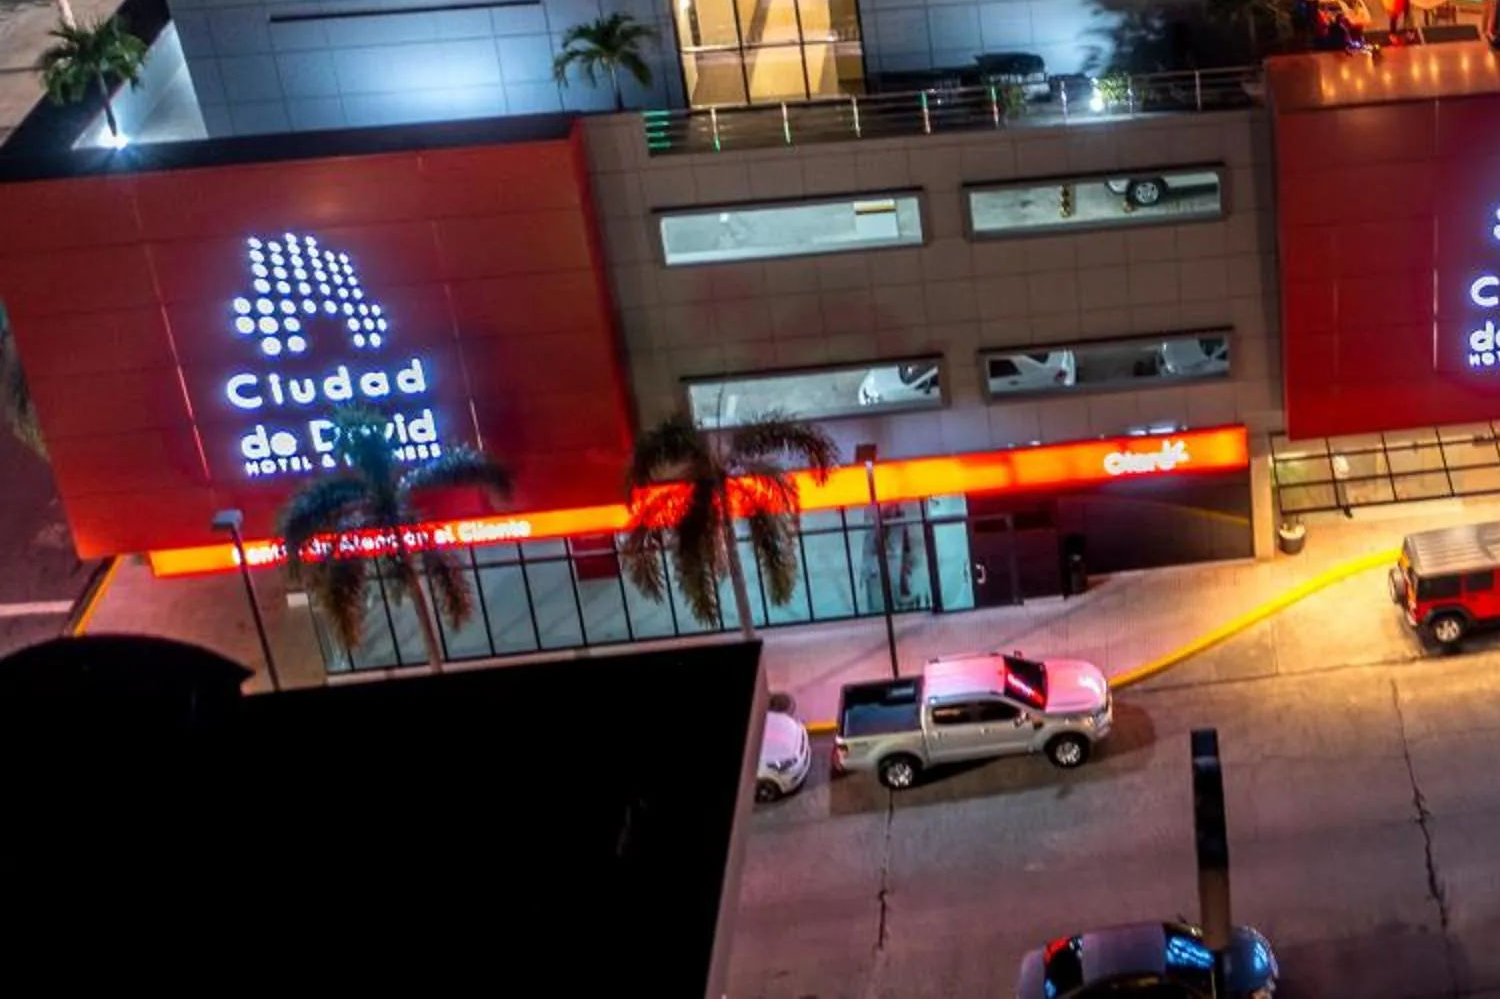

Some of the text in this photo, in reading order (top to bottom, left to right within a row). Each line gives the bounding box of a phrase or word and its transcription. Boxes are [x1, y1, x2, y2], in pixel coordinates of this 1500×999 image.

[226, 358, 427, 409] Ciudad
[241, 408, 437, 459] de Did
[245, 456, 312, 477] HOTEL
[232, 542, 303, 564] Cent
